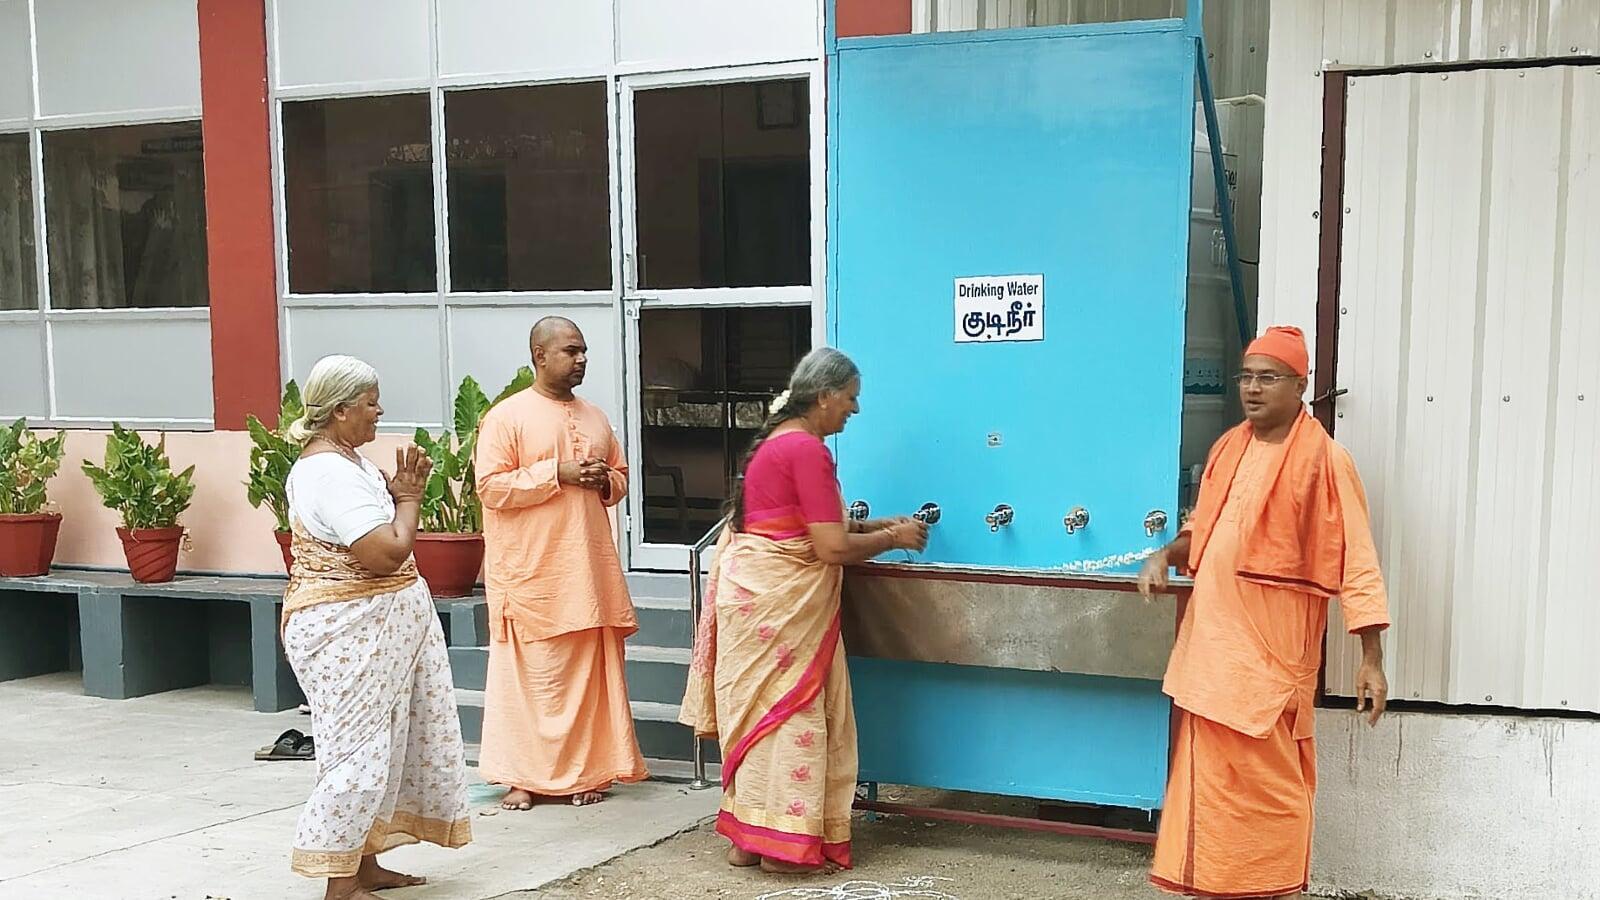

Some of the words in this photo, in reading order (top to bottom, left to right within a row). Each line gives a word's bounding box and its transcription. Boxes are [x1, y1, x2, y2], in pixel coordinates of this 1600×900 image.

[959, 282, 1004, 300] Drinking
[1007, 281, 1039, 296] Water
[963, 301, 1036, 338] குடிநீர்
